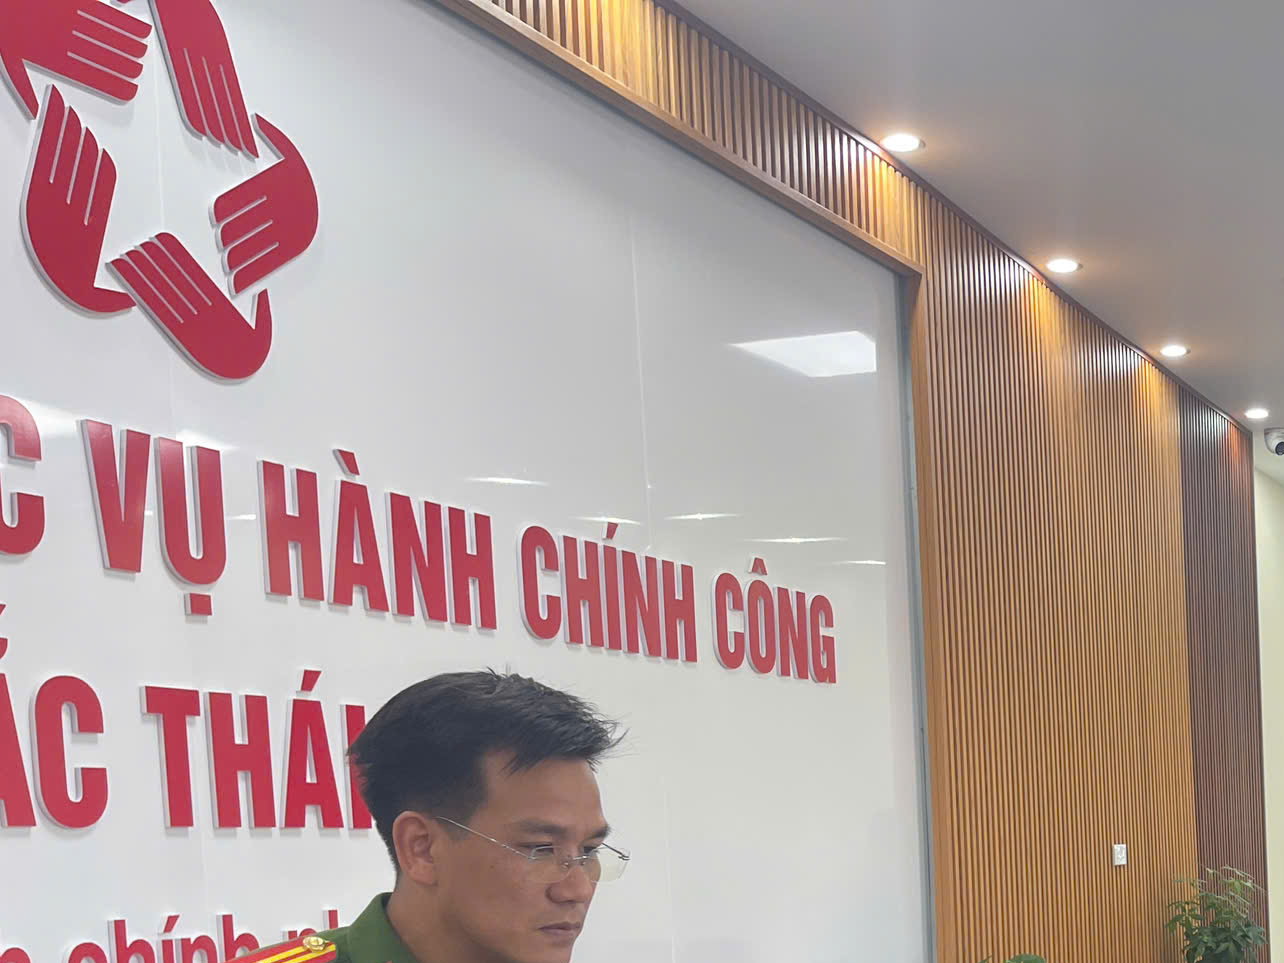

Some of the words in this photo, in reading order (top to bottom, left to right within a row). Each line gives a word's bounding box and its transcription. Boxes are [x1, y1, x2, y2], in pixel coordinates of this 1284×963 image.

[84, 419, 226, 615] VỤ
[259, 449, 497, 629] HÀNH
[520, 523, 697, 662] CHÍNH
[714, 558, 836, 683] CÔNG
